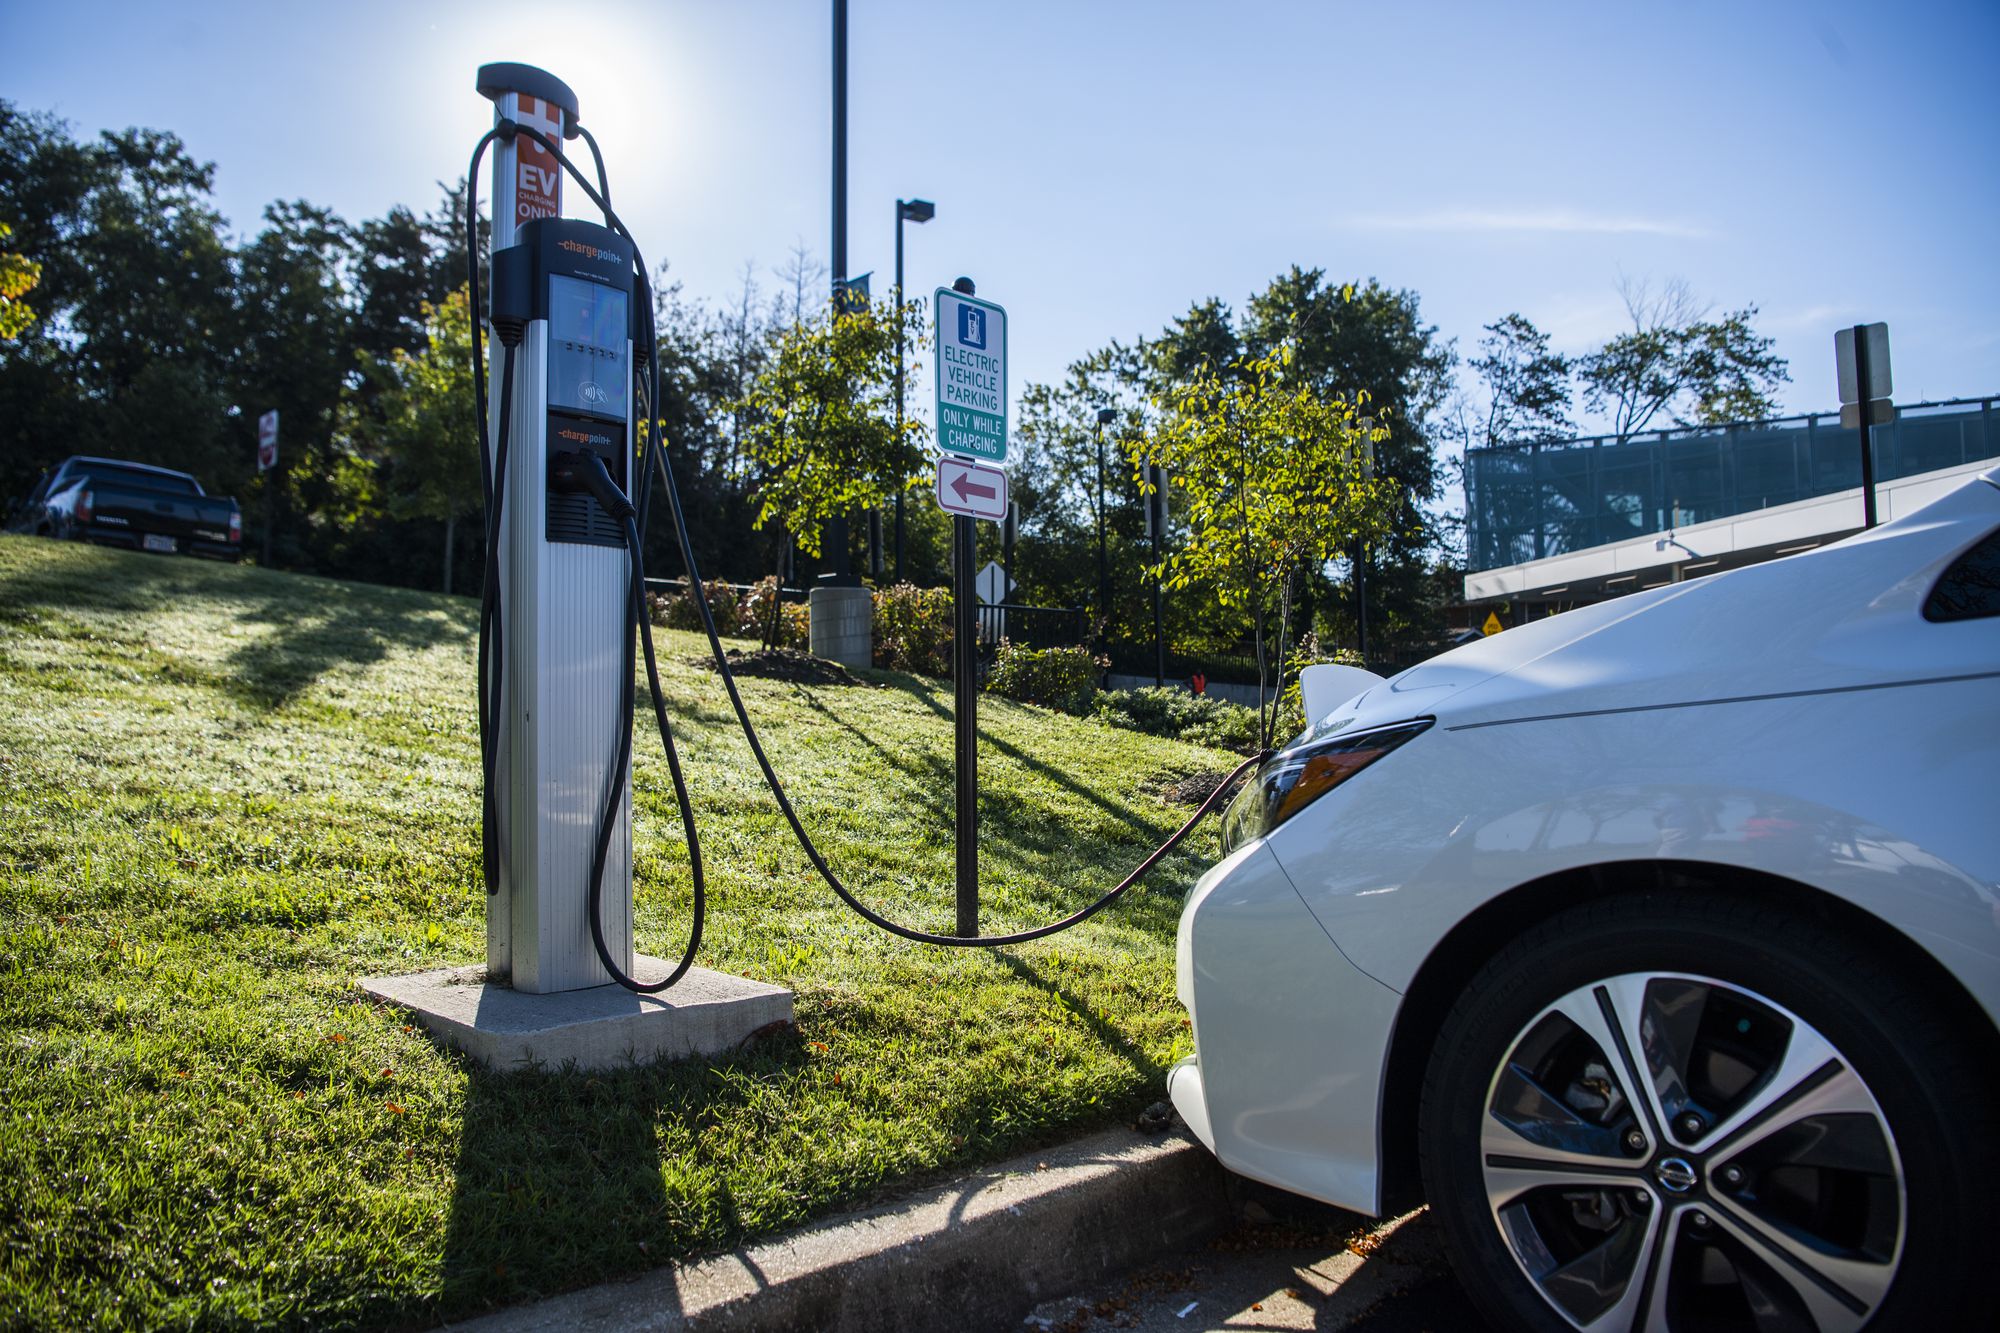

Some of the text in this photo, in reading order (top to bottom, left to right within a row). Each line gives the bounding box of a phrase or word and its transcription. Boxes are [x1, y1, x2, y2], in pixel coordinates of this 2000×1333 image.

[519, 162, 557, 197] EV
[518, 191, 556, 208] CHARGING
[945, 345, 999, 374] ELECTRIC
[948, 365, 997, 392] VEHICLE
[947, 384, 998, 410] PARKING
[943, 408, 1002, 436] ONLY WHILE
[948, 429, 997, 454] CHARGING
